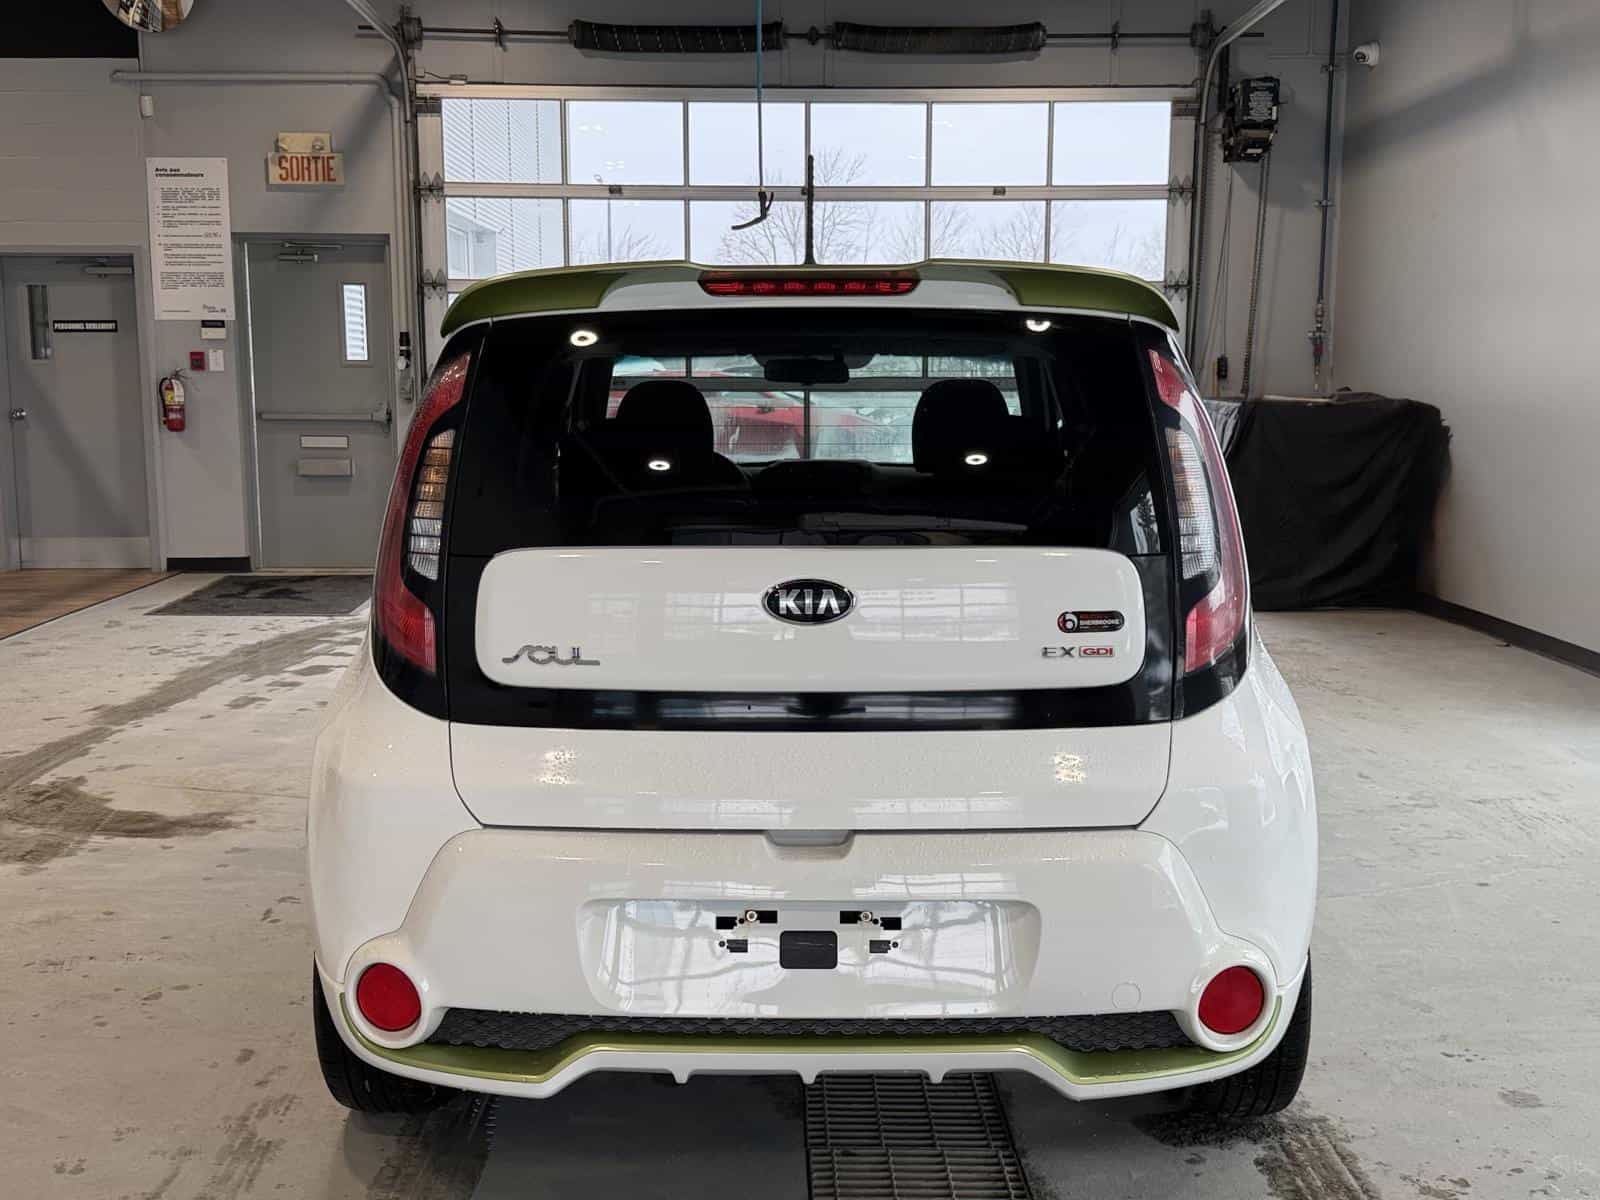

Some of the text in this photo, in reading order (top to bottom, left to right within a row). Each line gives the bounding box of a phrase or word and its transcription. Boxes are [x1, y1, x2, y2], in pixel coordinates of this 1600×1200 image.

[278, 155, 337, 182] SORTIE
[779, 589, 841, 614] KIA
[502, 645, 600, 666] SOUL
[1041, 646, 1113, 658] EX GDI
